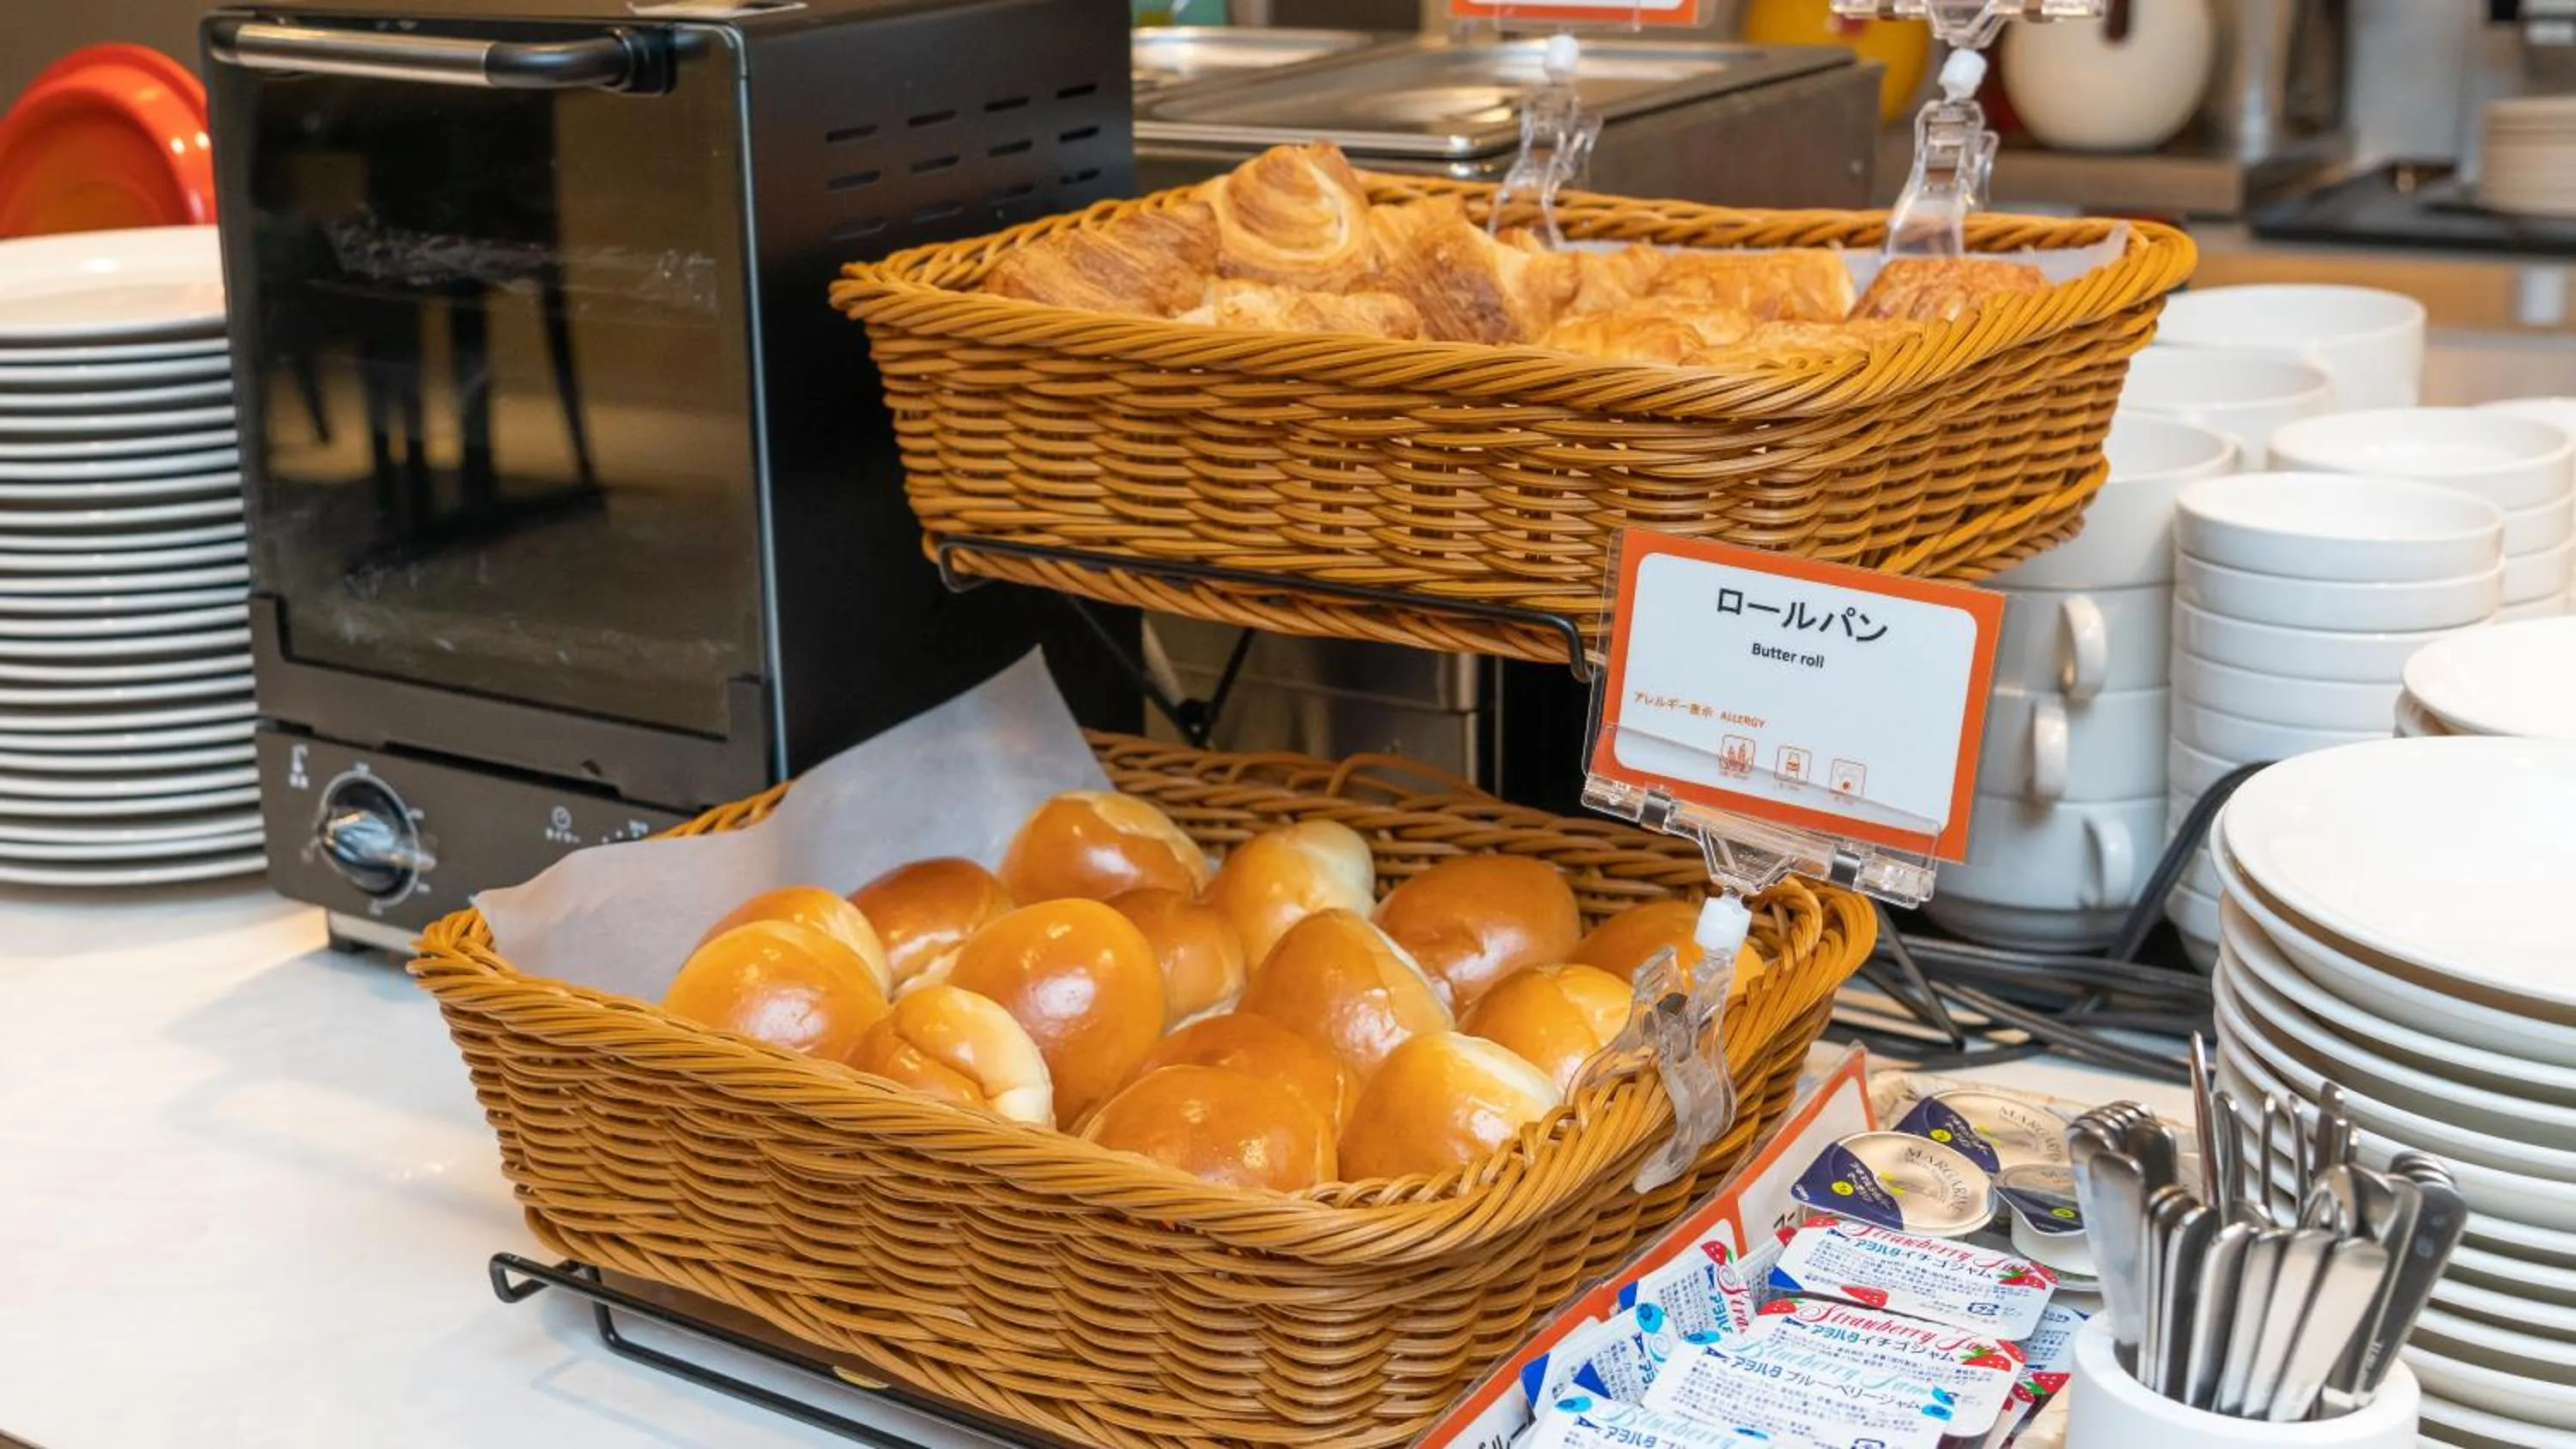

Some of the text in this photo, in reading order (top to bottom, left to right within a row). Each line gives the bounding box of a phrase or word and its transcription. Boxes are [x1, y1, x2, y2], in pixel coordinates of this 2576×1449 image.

[1717, 588, 1888, 643] ロールパン
[1752, 642, 1825, 669] Butter roll
[1720, 711, 1767, 729] ALLERGY
[1841, 1223, 1975, 1262] Strawberry
[1795, 1303, 1938, 1345] Strawberry
